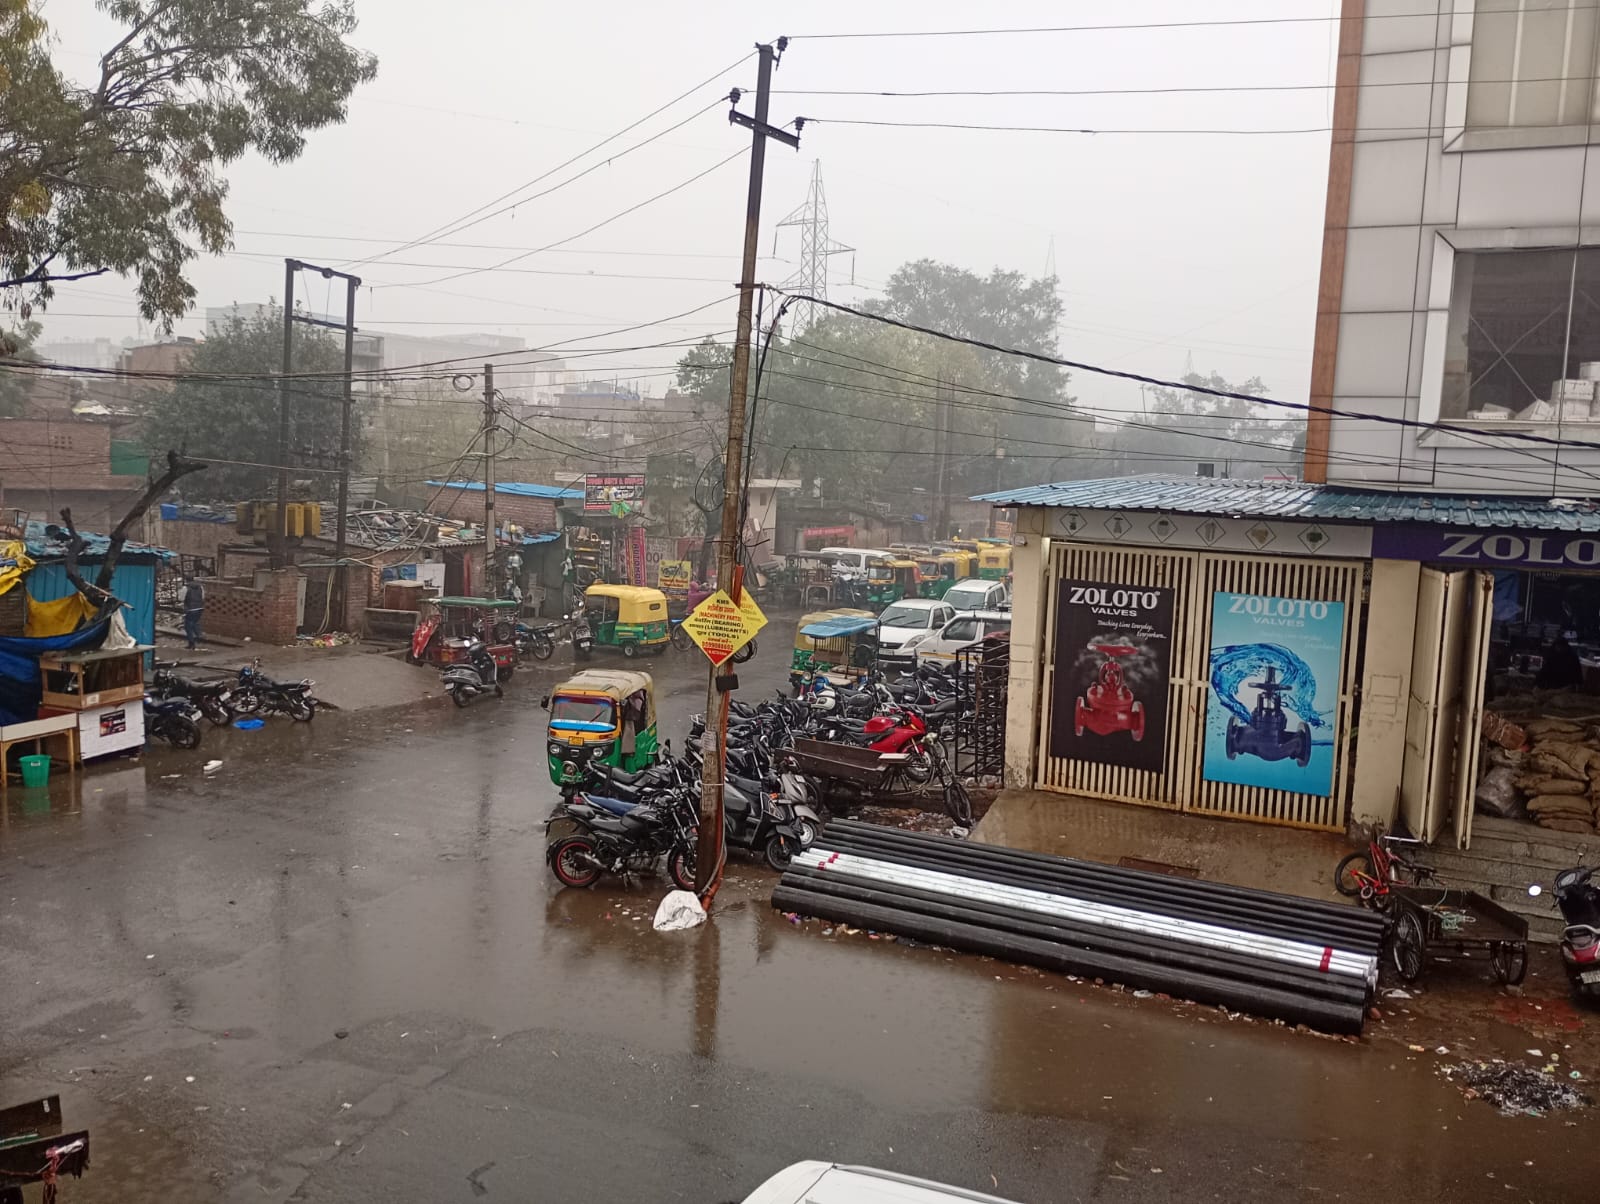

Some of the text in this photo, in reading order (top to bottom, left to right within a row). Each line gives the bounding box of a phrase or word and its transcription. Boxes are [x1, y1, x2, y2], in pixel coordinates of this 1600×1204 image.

[1069, 586, 1158, 610] ZOLOTO
[1091, 606, 1138, 617] VALVES
[1228, 595, 1328, 620] ZOLOTO
[1253, 616, 1305, 628] VALVES
